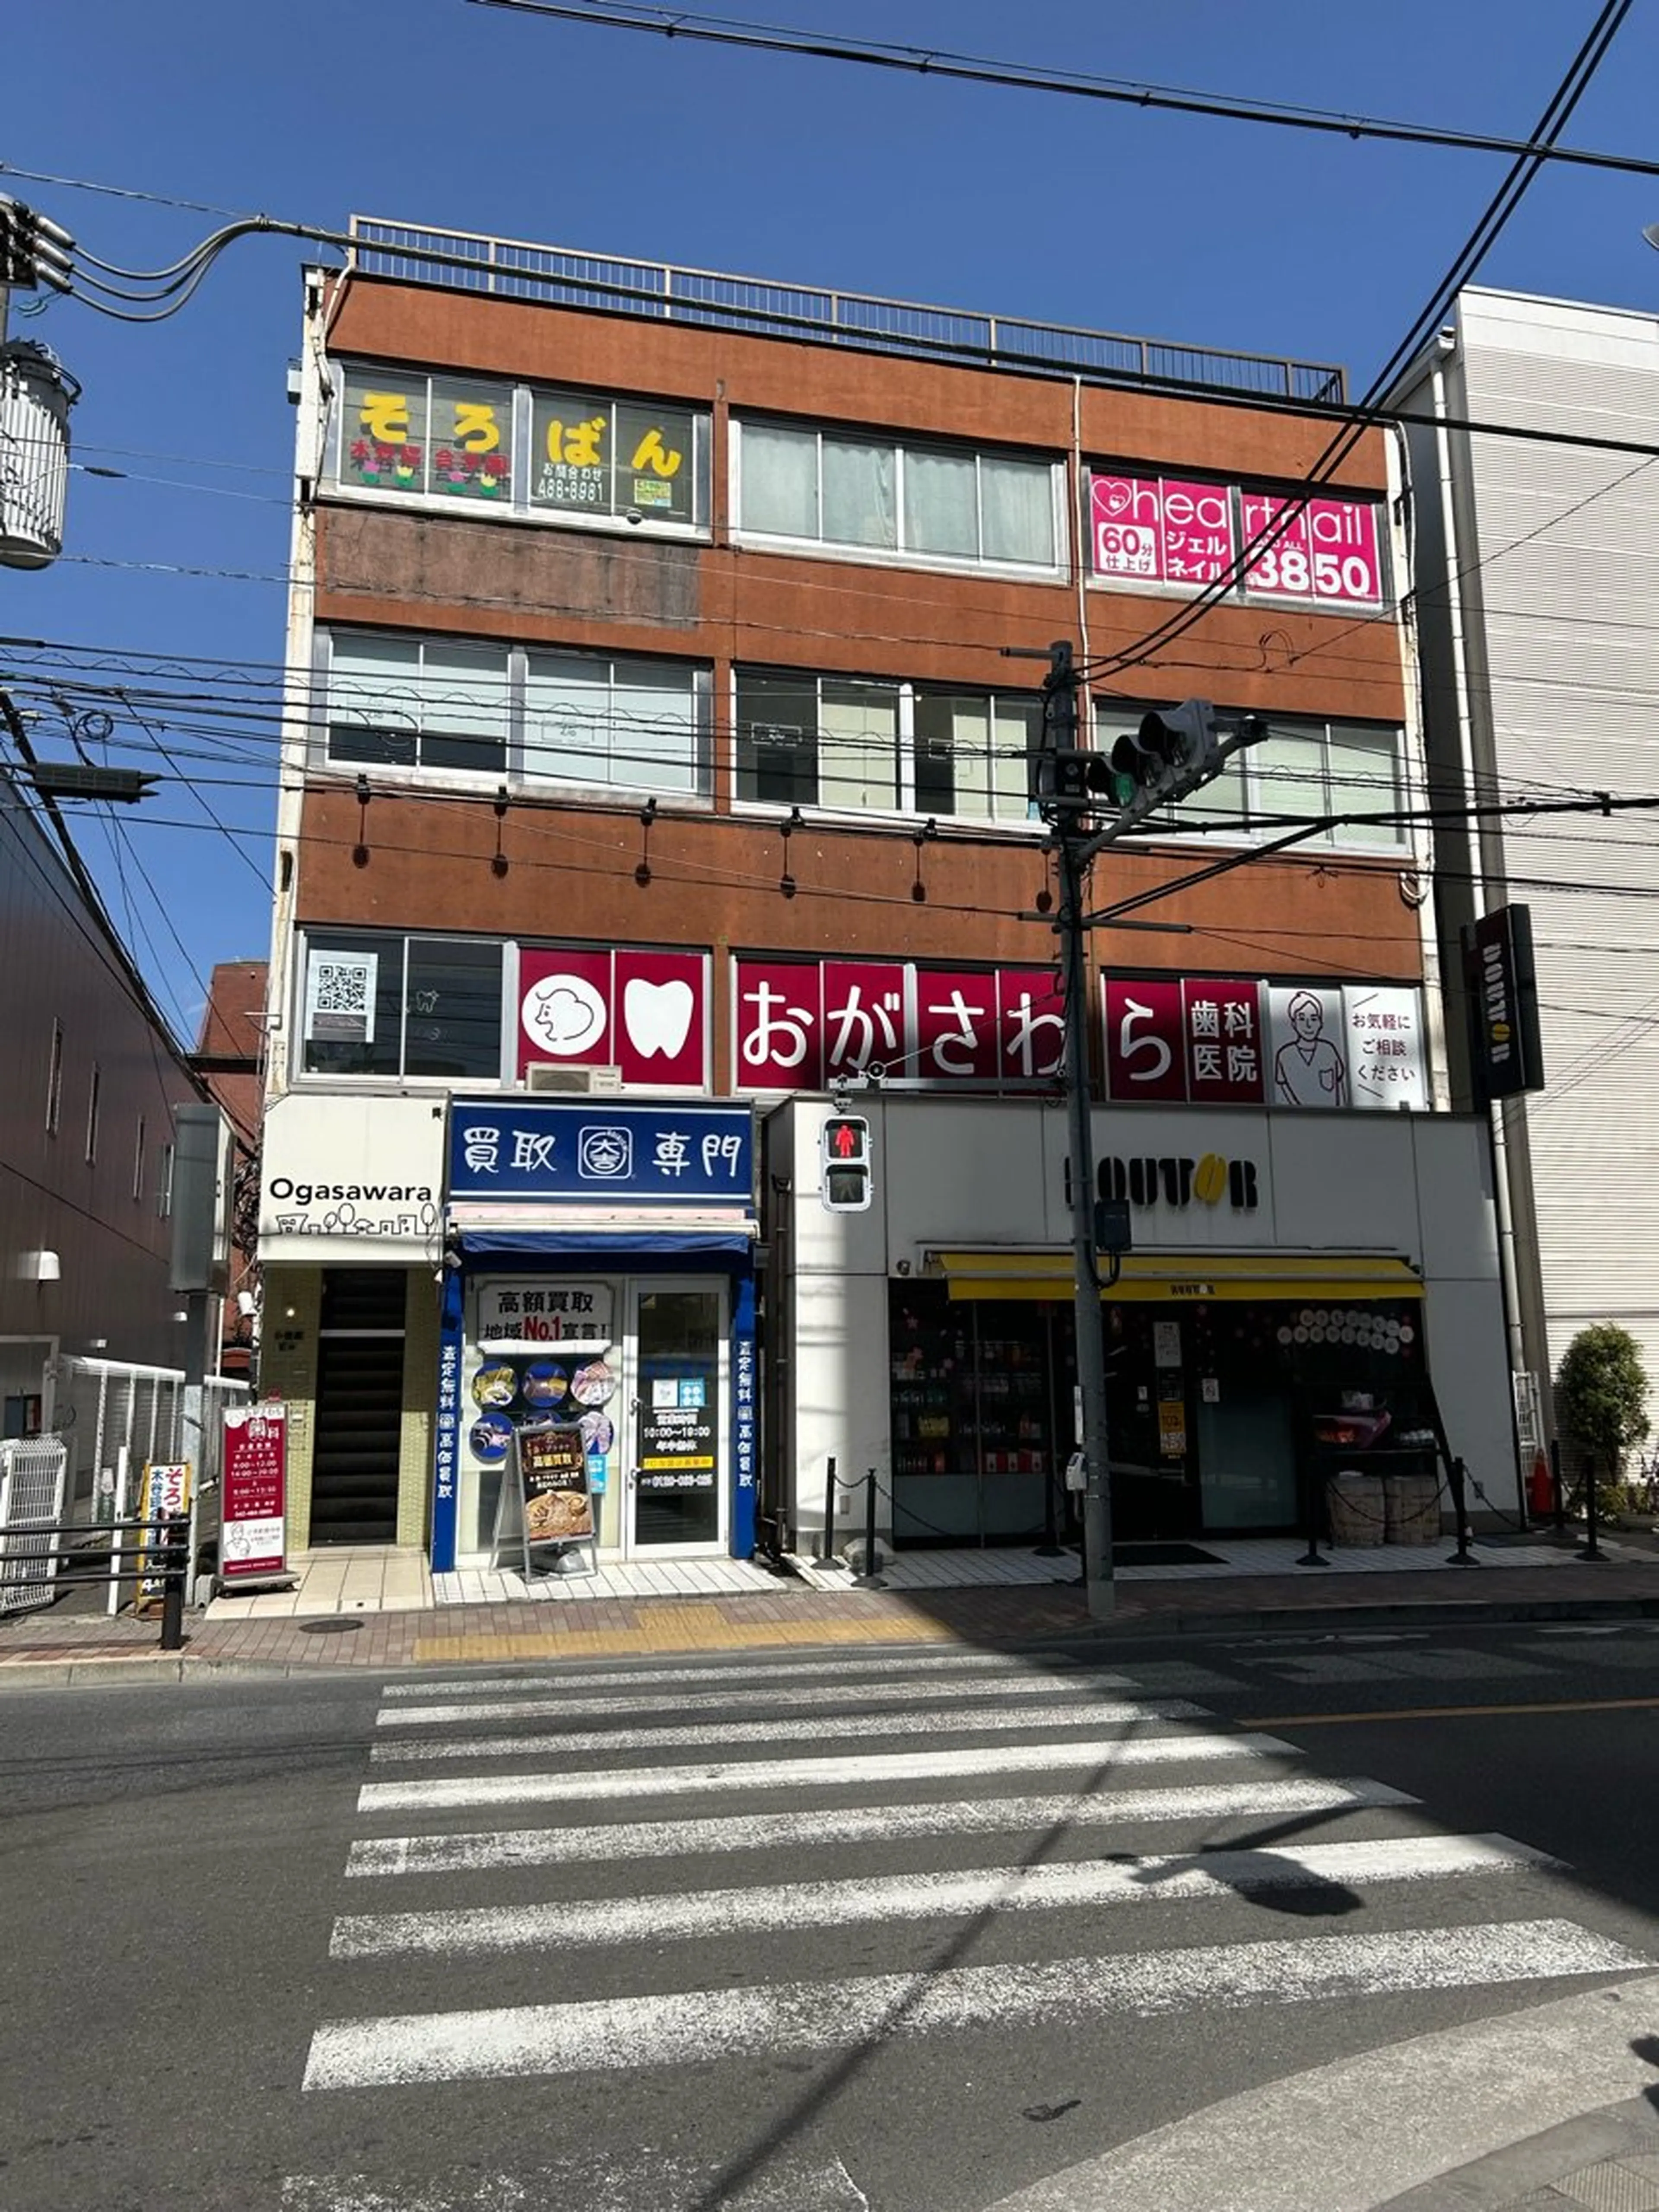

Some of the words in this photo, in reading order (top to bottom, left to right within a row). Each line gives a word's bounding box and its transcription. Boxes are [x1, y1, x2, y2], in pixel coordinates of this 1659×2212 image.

[360, 392, 681, 477] そろばん
[1102, 526, 1152, 556] 60分
[1166, 531, 1227, 556] ジェル
[1106, 555, 1150, 572] 仕上げ
[1168, 557, 1222, 581] ネイル
[1482, 942, 1510, 1064] DOUTOR
[1191, 1000, 1254, 1039] 歯科
[1352, 1012, 1411, 1030] お気軽に
[1361, 1039, 1407, 1057] ご相談
[1193, 1044, 1257, 1082] 医院
[1357, 1065, 1416, 1082] ください
[463, 1126, 558, 1174] 買取
[652, 1131, 742, 1178] 専門
[270, 1178, 432, 1205] Ogasawara
[1065, 1152, 1258, 1208] OUTOR
[498, 1290, 594, 1313] 高額買取
